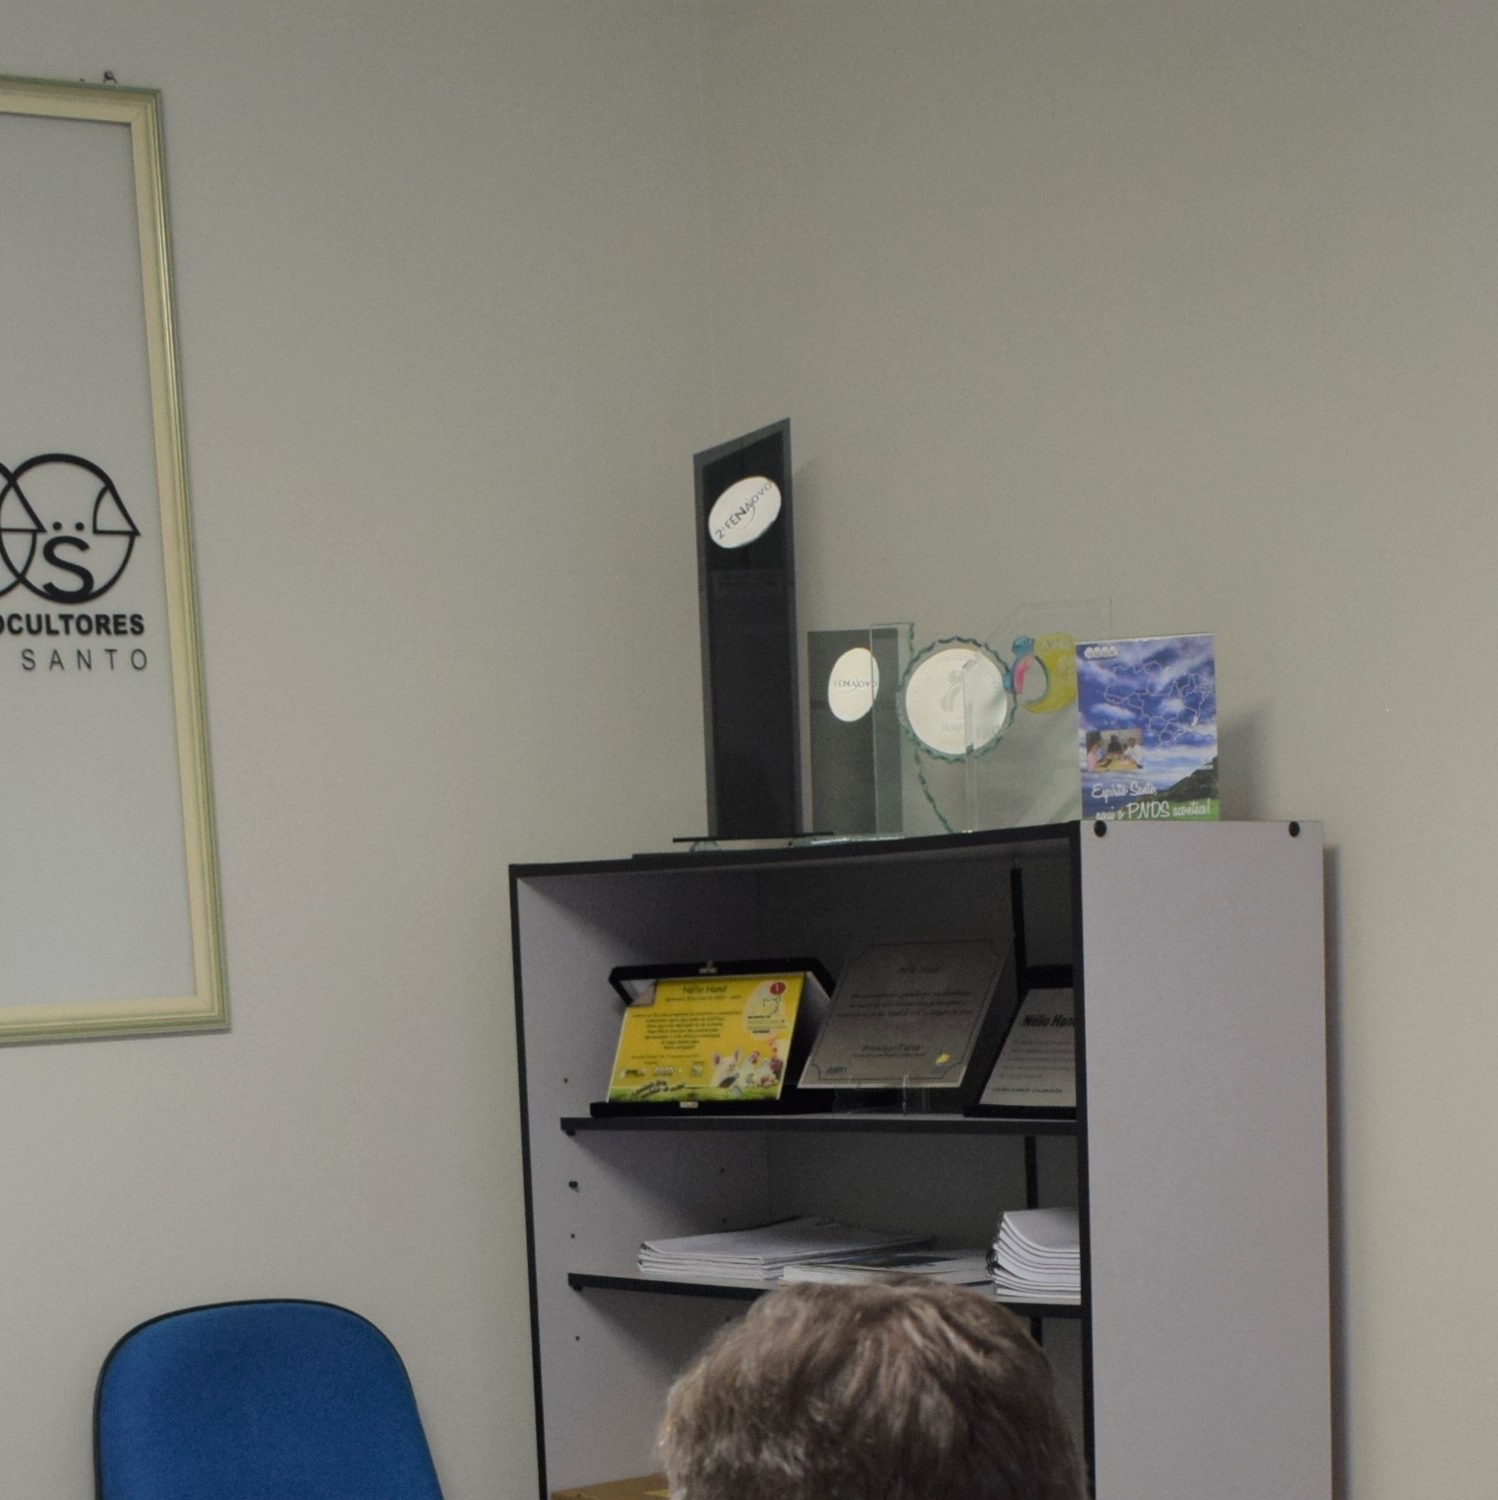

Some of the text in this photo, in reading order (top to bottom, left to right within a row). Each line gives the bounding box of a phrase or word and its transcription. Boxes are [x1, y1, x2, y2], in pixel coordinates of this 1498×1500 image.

[21, 647, 149, 671] SANTO
[1126, 800, 1170, 820] PNDS
[1051, 1013, 1074, 1027] Han
